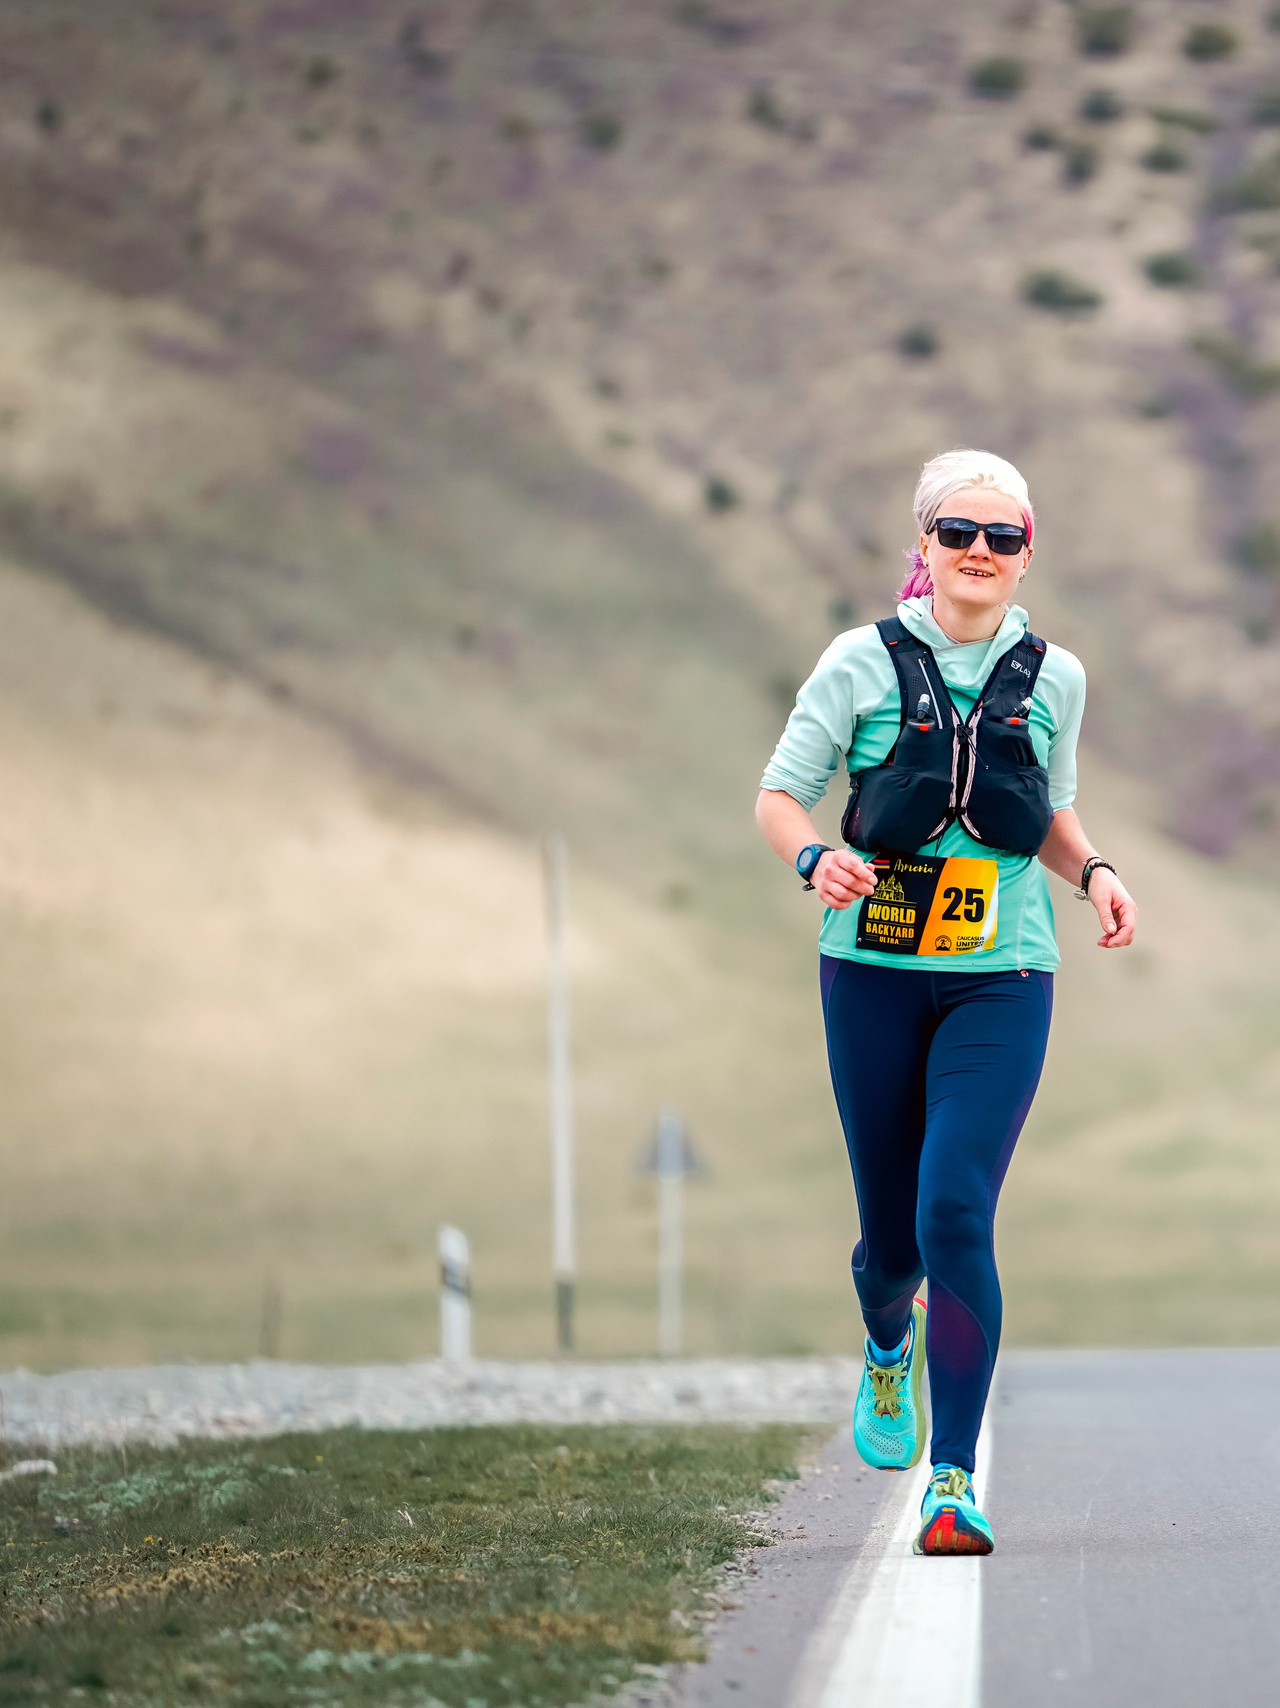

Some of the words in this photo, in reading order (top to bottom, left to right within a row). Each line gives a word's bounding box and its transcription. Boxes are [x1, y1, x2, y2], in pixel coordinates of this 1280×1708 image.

[894, 859, 936, 874] Armenia
[942, 887, 985, 923] 25
[868, 904, 916, 924] WORLD
[866, 922, 915, 938] BACKYARD
[879, 936, 899, 945] ULTRA
